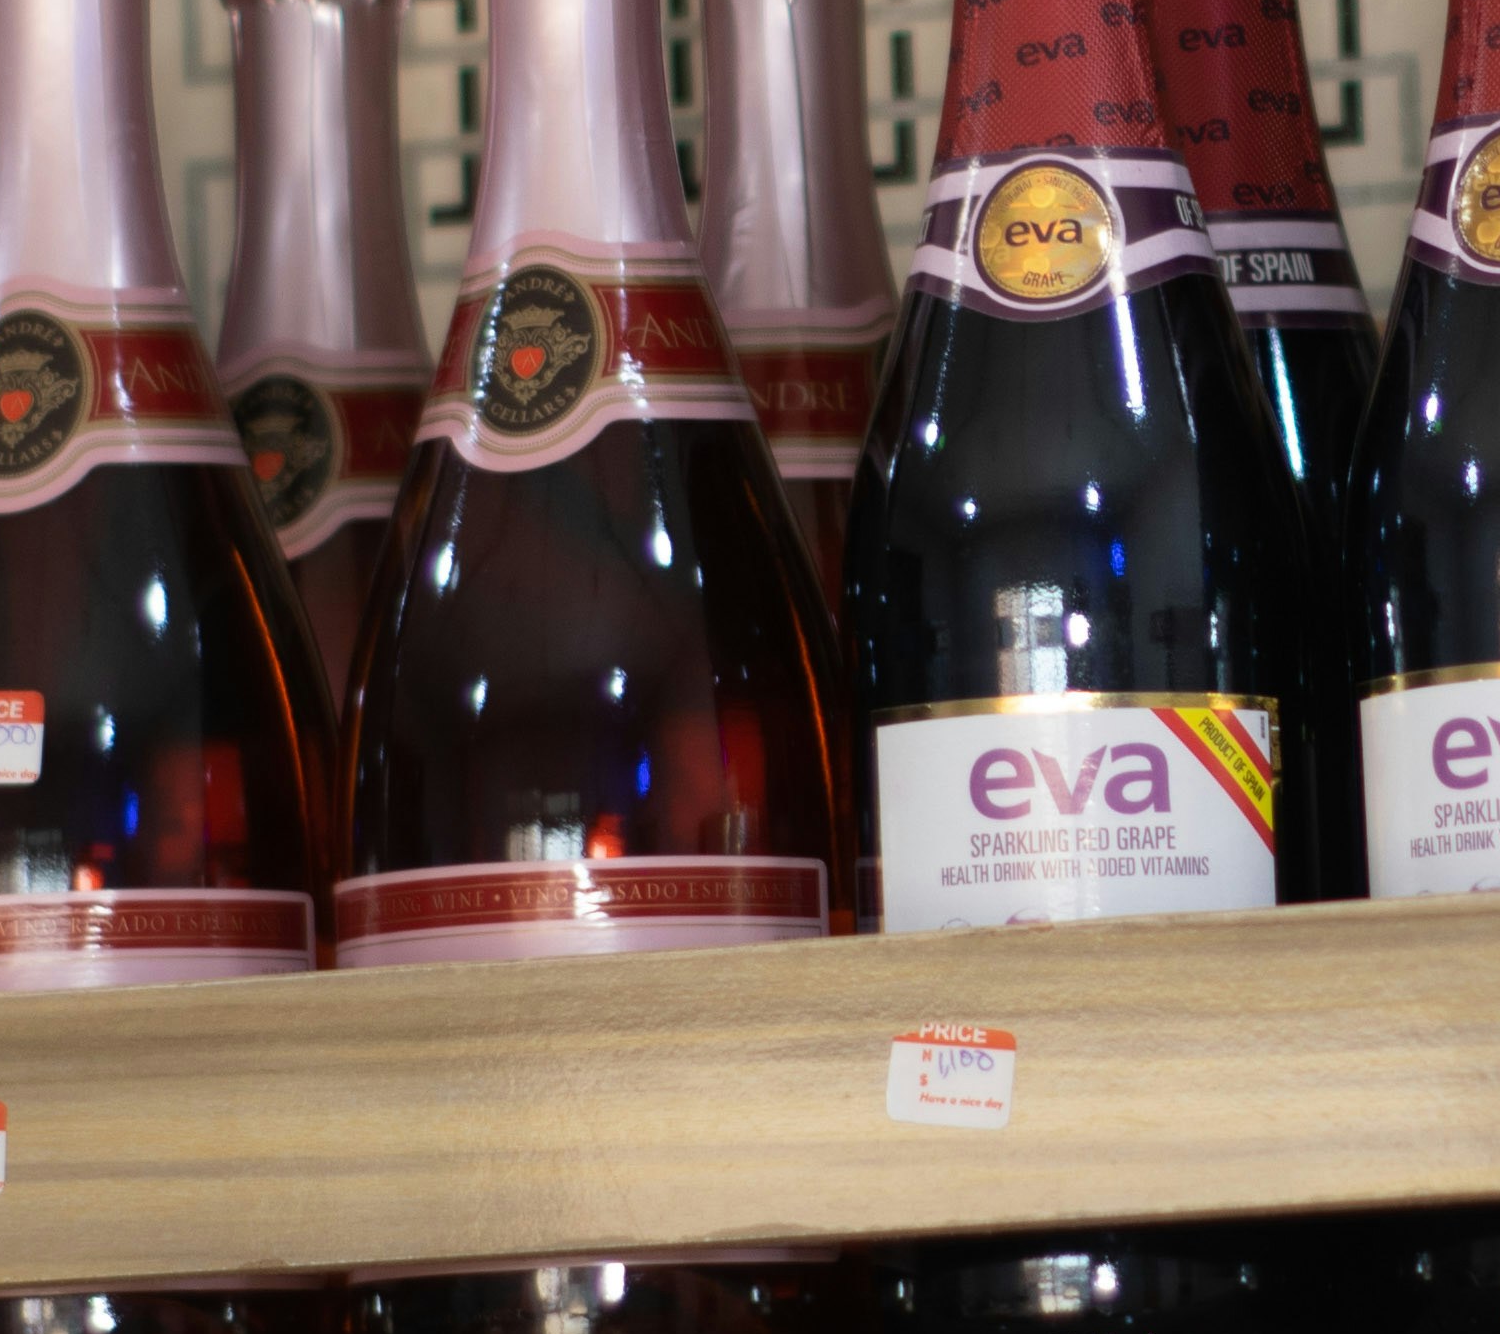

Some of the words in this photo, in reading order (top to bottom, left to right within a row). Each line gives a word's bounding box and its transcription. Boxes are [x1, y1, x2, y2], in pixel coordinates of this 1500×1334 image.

[1015, 32, 1088, 68] eva
[1004, 218, 1083, 247] eva
[489, 394, 566, 424] CELLARS
[1198, 716, 1238, 762] PRODUCT
[1232, 756, 1247, 773] OF
[968, 741, 1172, 821] eva
[1239, 769, 1267, 803] SPAIN
[970, 830, 1069, 859] SPARKLING
[1075, 828, 1110, 852] RED
[1116, 826, 1176, 851] GRAPE
[1410, 835, 1452, 859] HEALTH
[1455, 830, 1496, 852] DRINK
[941, 865, 990, 887] HEALTH
[993, 862, 1036, 882] DRINK
[1041, 859, 1081, 879] WITH
[1140, 855, 1210, 877] VITAMINS
[919, 1022, 988, 1044] PRICE
[920, 1093, 946, 1105] Have
[960, 1095, 981, 1107] nice
[985, 1097, 1004, 1110] day
